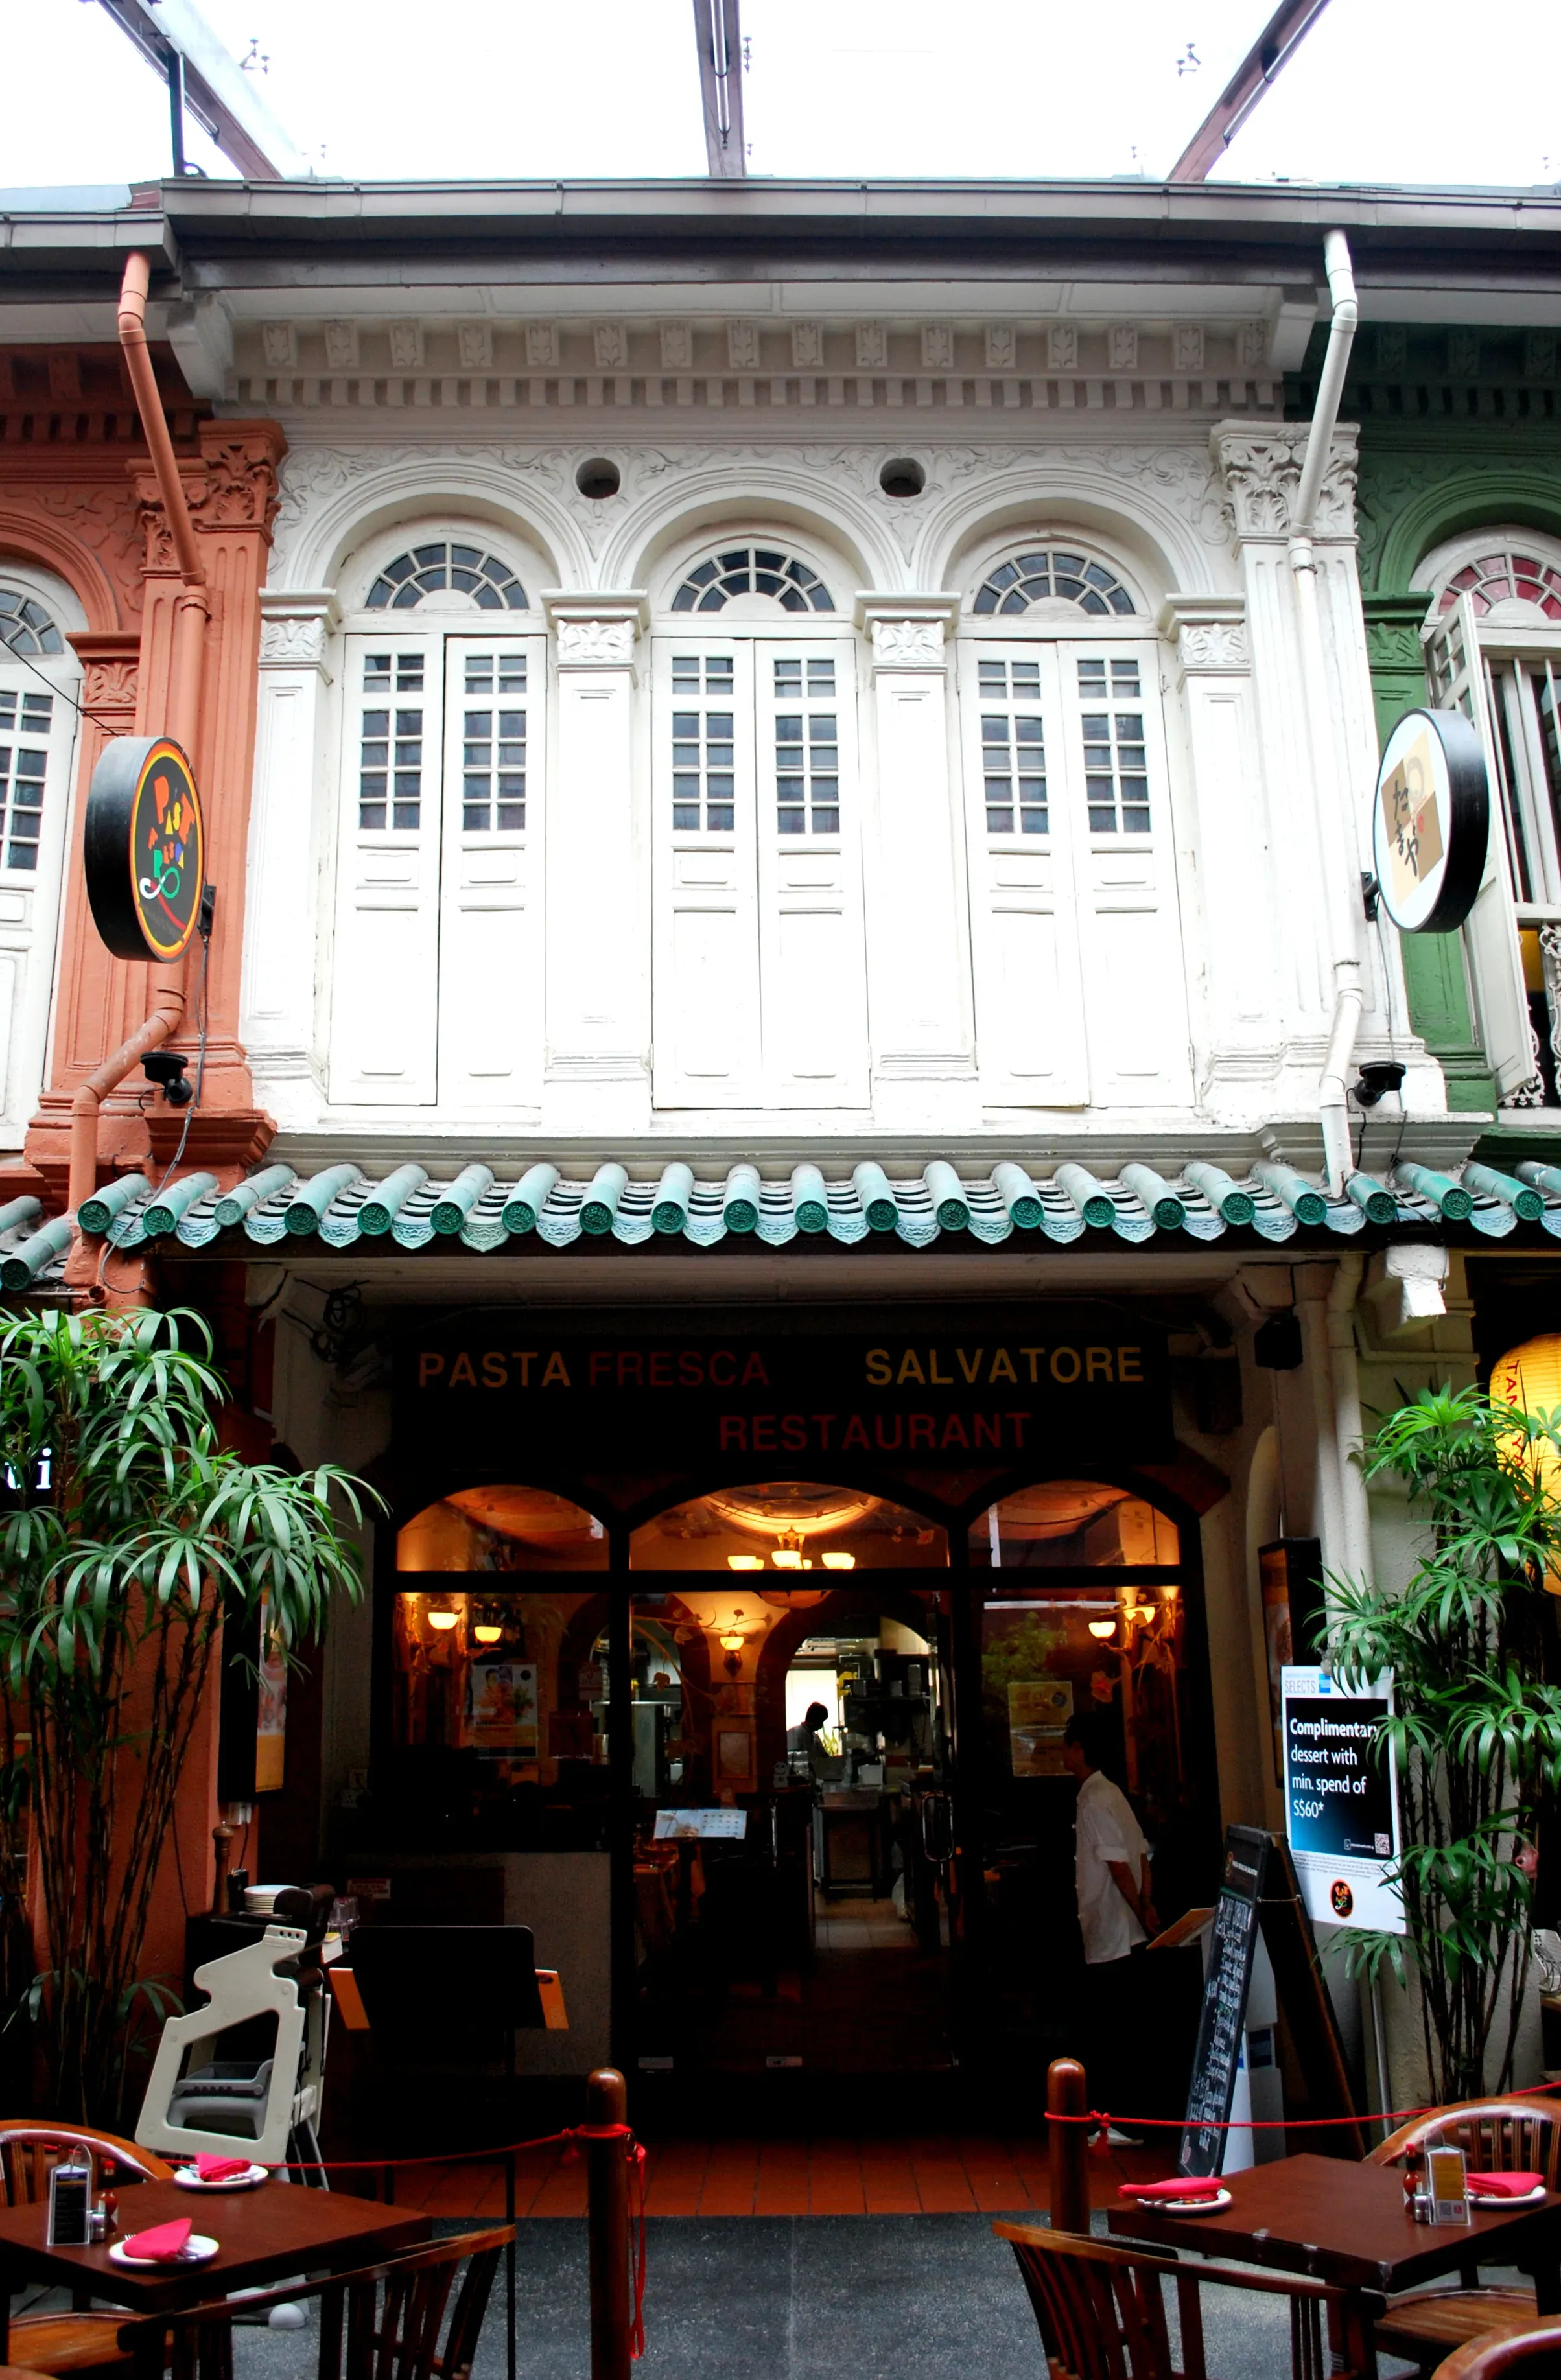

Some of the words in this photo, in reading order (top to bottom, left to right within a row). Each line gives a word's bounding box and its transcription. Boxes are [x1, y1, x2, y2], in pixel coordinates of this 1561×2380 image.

[419, 1351, 571, 1388] PASTA
[589, 1351, 769, 1386] FRESCA
[865, 1346, 1144, 1386] SALVATORE
[719, 1412, 1031, 1451] RESTAURANT
[1284, 1679, 1315, 1694] SELECTS
[1291, 1744, 1329, 1764] dessert
[1332, 1747, 1358, 1766] with
[1292, 1773, 1314, 1790] min.
[1316, 1775, 1350, 1796] spend
[1352, 1776, 1367, 1794] of
